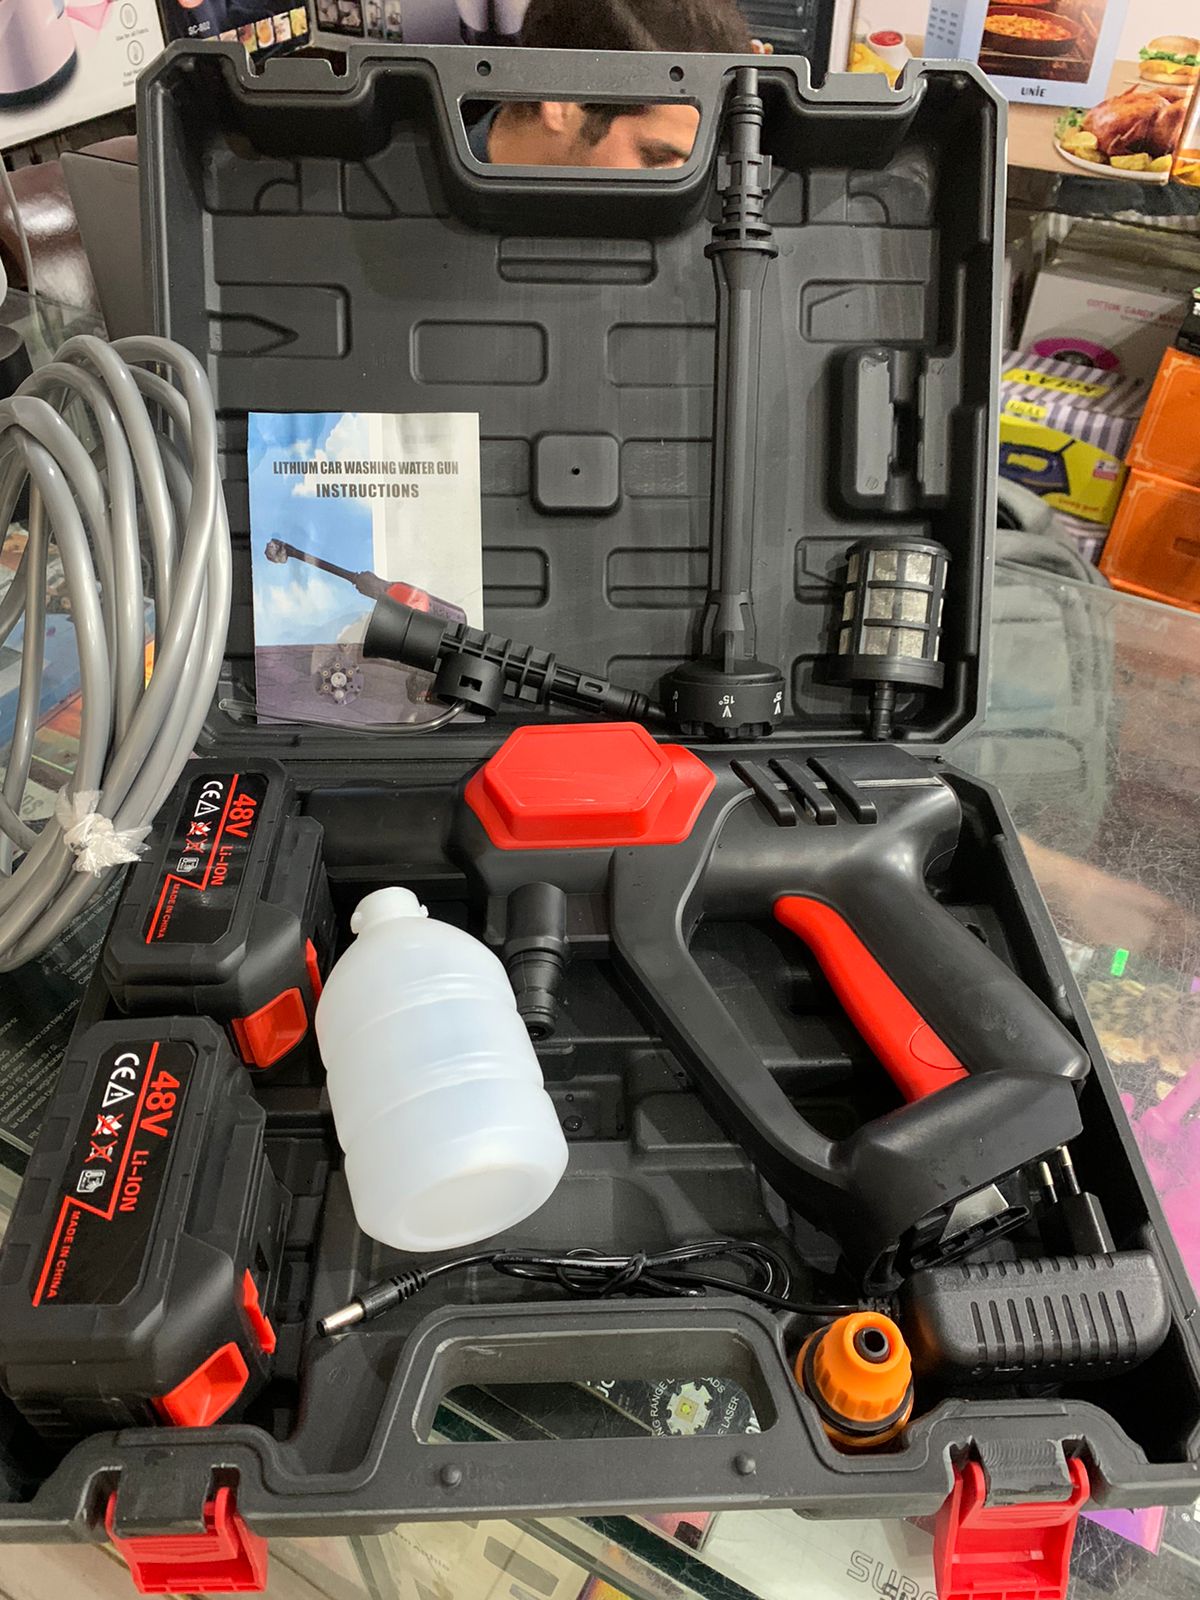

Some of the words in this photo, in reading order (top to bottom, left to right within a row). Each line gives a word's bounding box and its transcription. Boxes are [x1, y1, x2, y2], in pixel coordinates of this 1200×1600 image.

[273, 461, 318, 475] LITHIUM
[320, 461, 343, 475] CAR
[344, 461, 397, 475] WASHING
[398, 461, 435, 475] WATER
[436, 461, 459, 475] GUN
[316, 483, 420, 498] INSTRUCTIONS
[200, 780, 224, 799] CE
[224, 793, 257, 838] 48V
[211, 845, 234, 886] Li-ION
[165, 905, 174, 913] IN
[167, 883, 181, 905] MADE
[156, 914, 171, 939] CHINA
[110, 1052, 140, 1081] CE
[139, 1070, 180, 1138] 48V
[119, 1150, 149, 1213] Li-ION
[64, 1210, 81, 1244] MADE
[60, 1246, 71, 1258] IN
[46, 1260, 66, 1298] CHINA
[650, 1381, 669, 1418] RANGE
[721, 1396, 740, 1428] LASER
